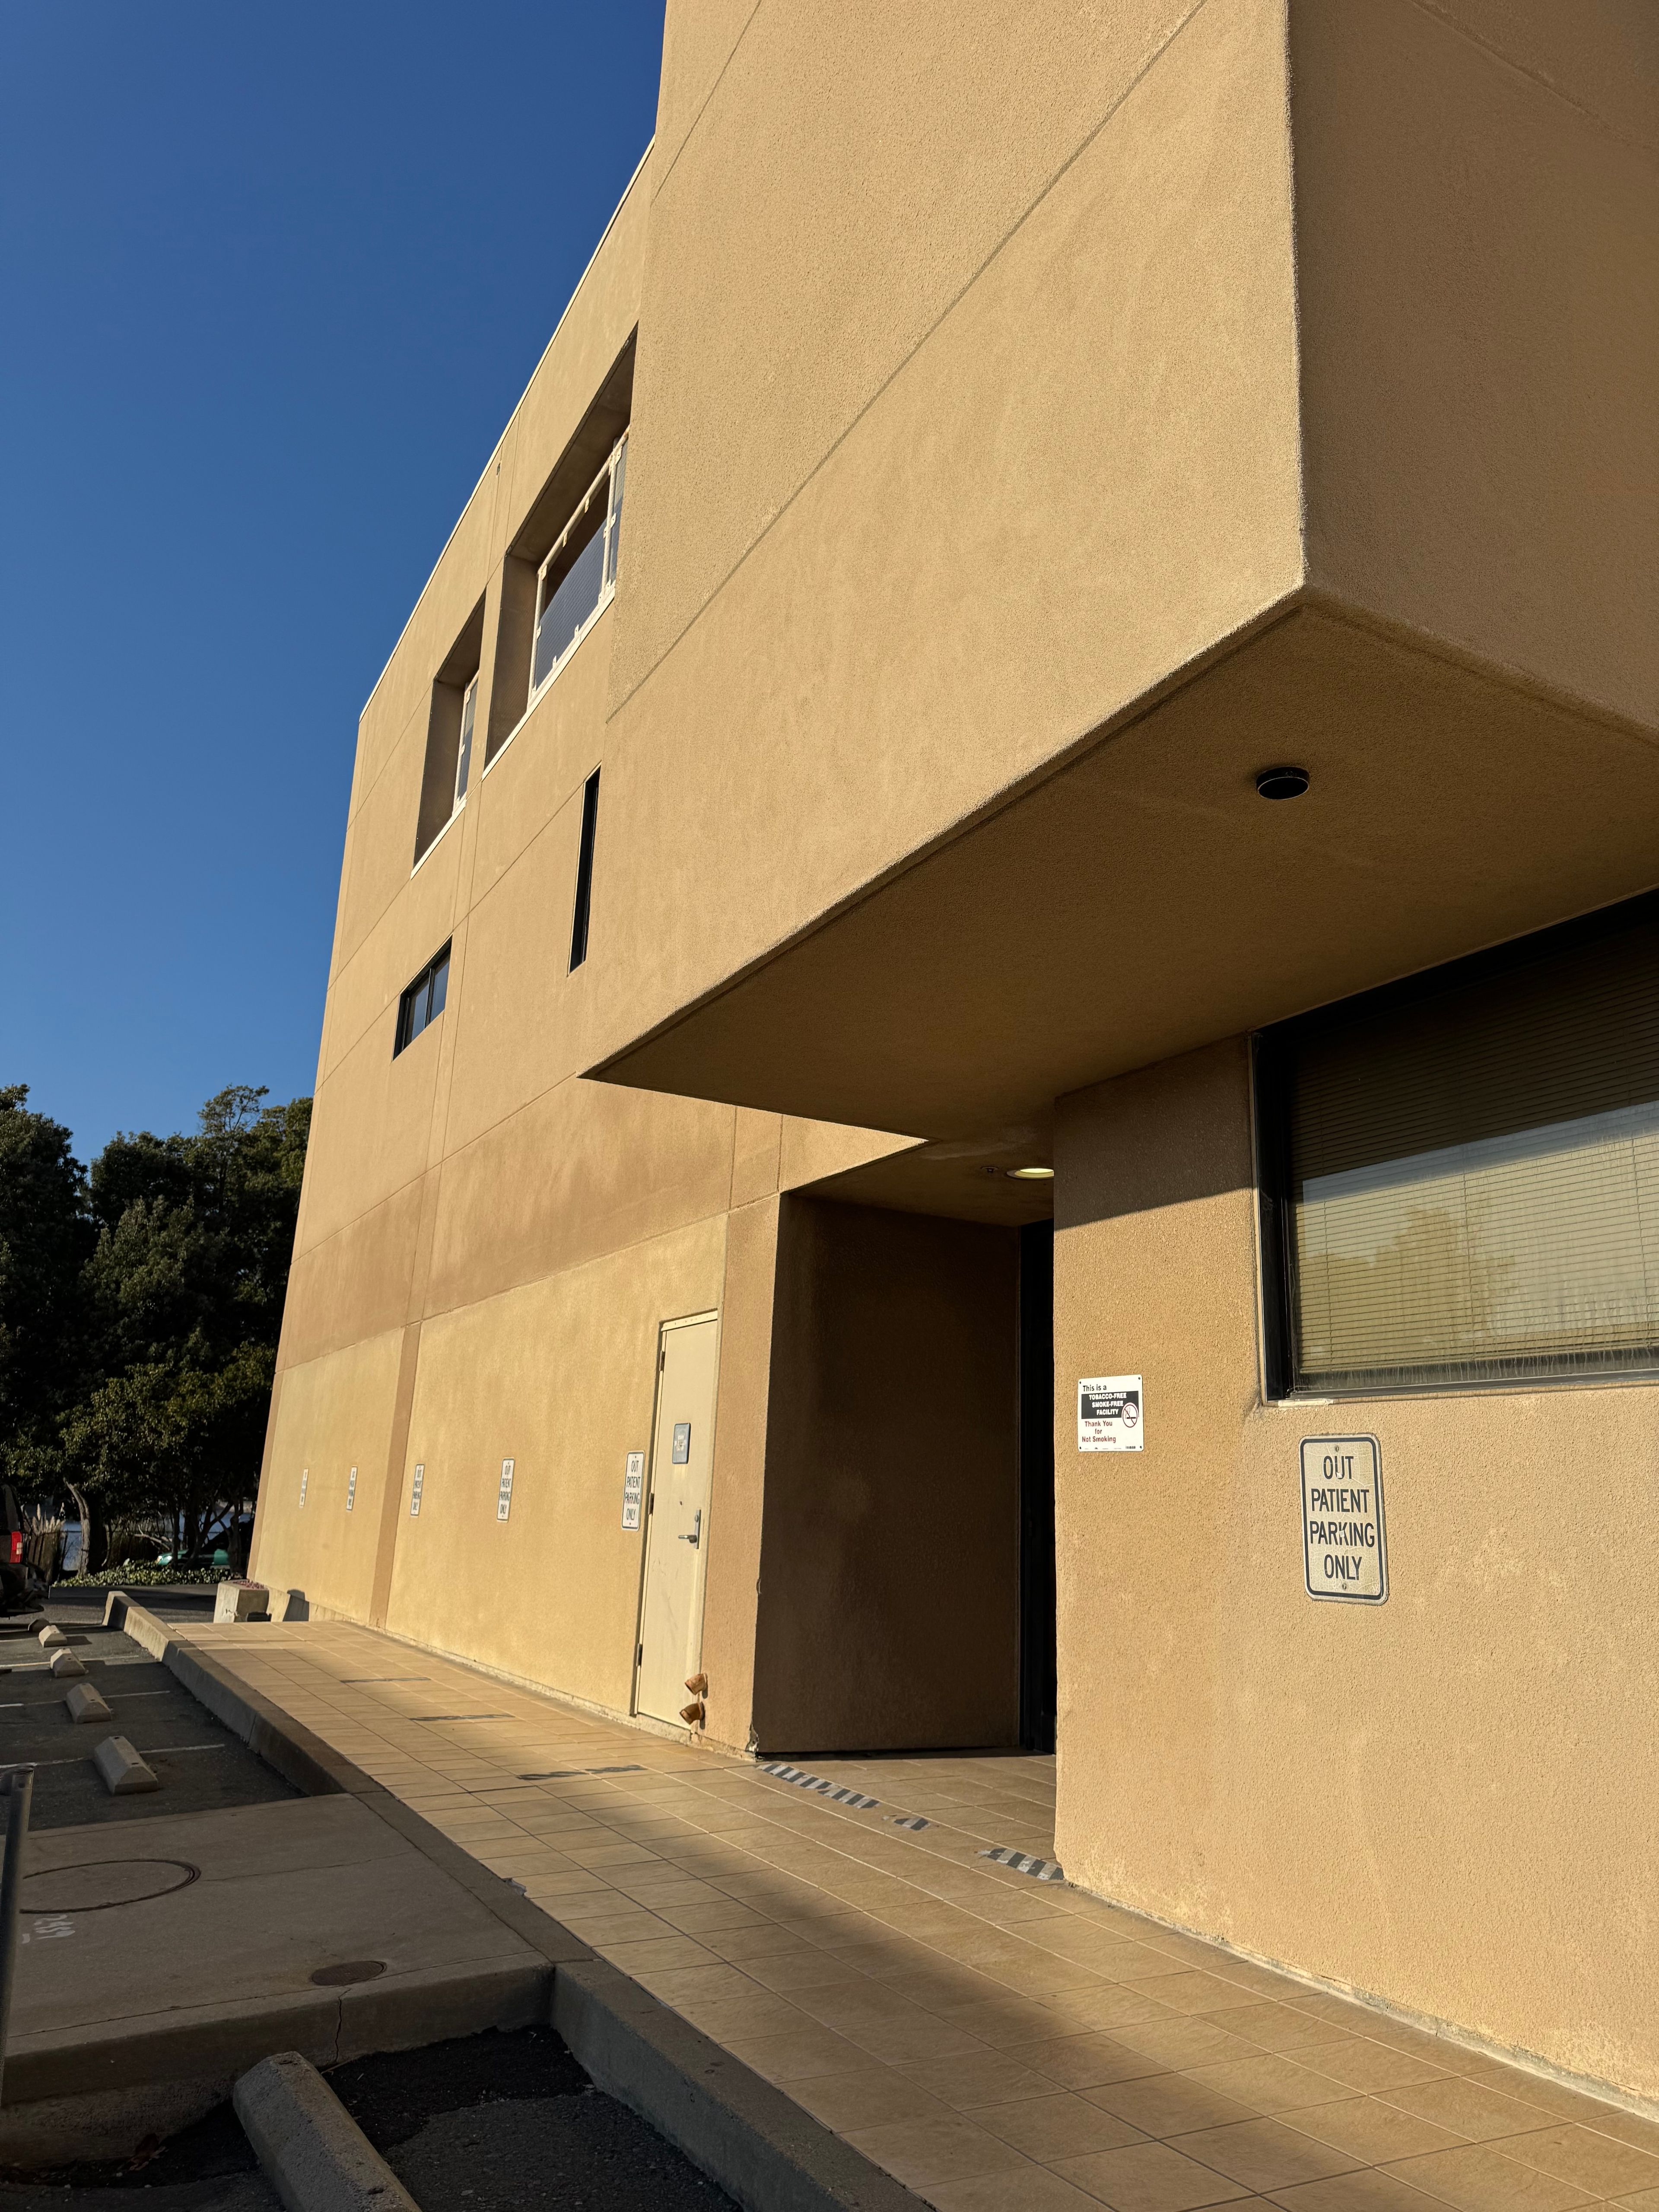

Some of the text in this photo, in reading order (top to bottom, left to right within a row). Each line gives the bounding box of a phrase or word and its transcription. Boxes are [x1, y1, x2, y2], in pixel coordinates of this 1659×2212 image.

[1323, 1456, 1354, 1480] OUT
[1311, 1488, 1370, 1513] PATIENT
[1309, 1521, 1375, 1548] PARKING
[1324, 1554, 1362, 1580] ONLY
